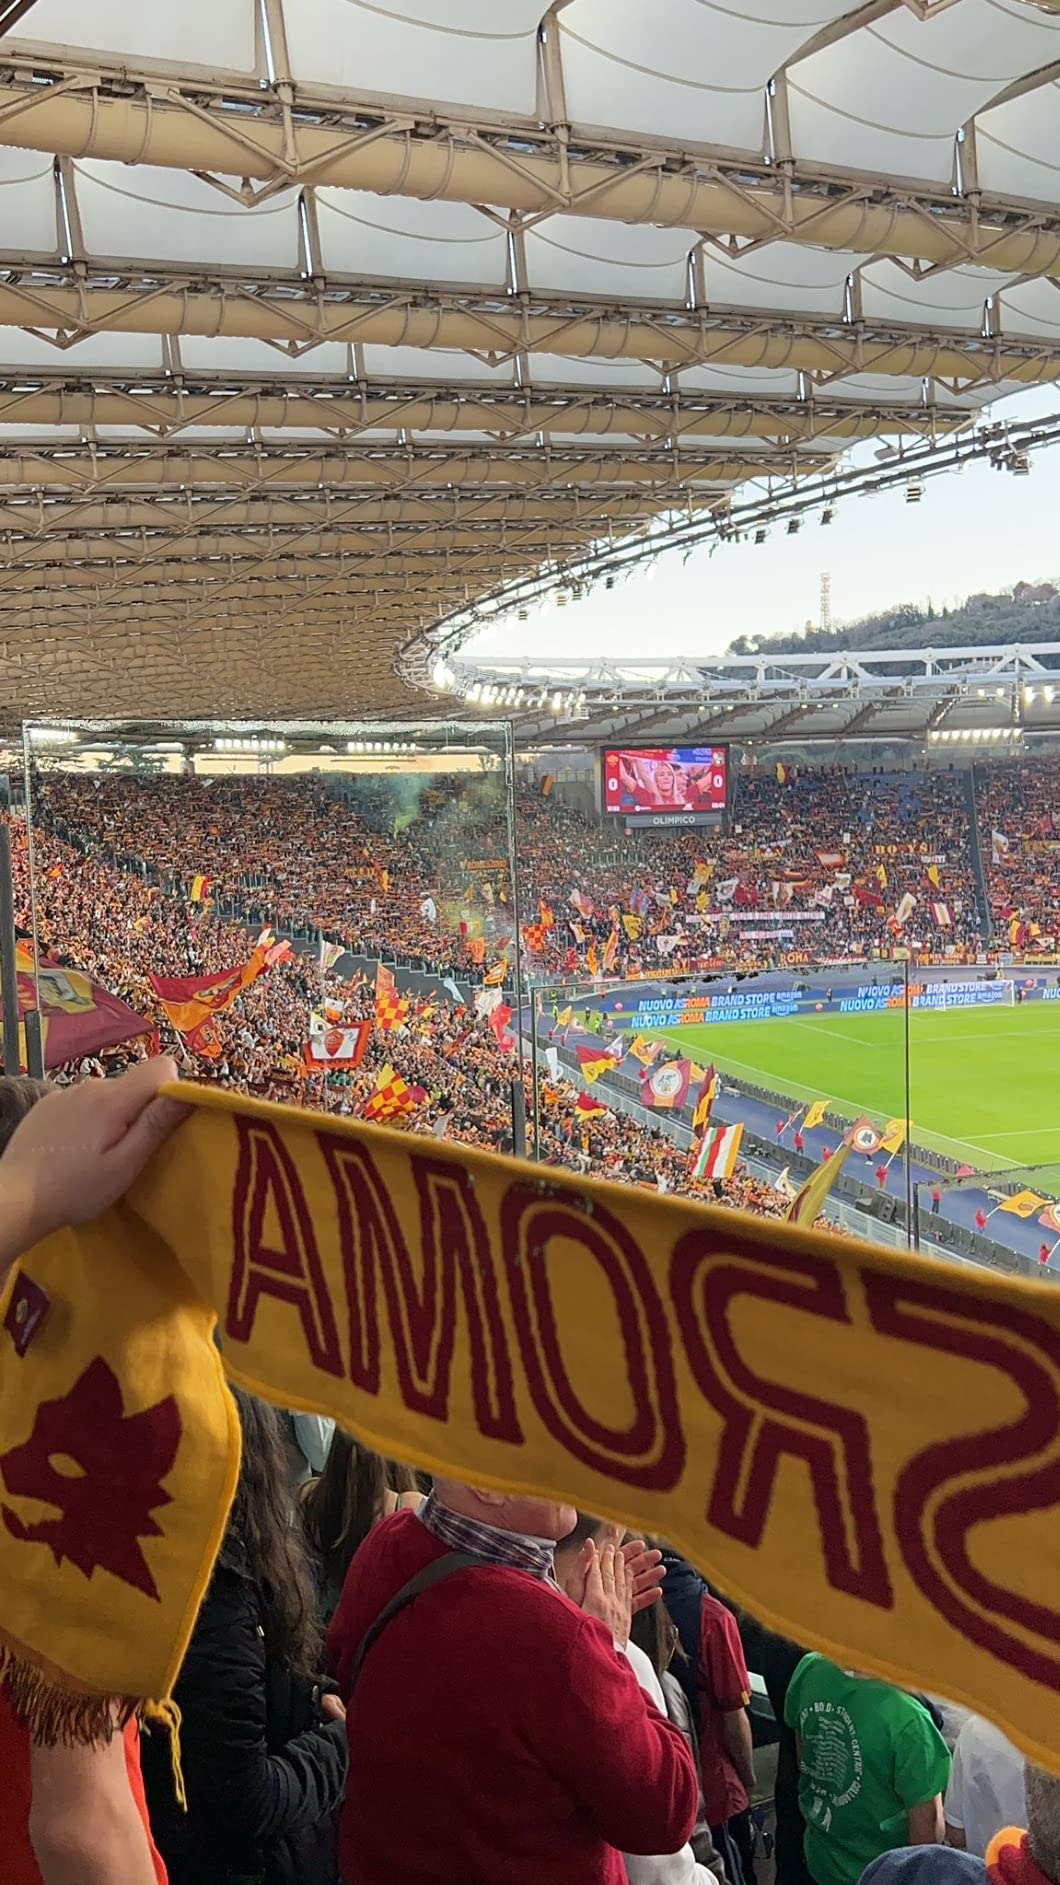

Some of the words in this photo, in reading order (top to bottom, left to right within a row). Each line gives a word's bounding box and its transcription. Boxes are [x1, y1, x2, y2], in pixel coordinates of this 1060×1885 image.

[608, 778, 618, 791] 0
[713, 775, 723, 788] 0
[652, 816, 696, 825] OLIMPICO
[639, 999, 674, 1012] NUOVO
[711, 994, 745, 1007] BRAND
[745, 992, 776, 1005] STORE
[776, 991, 802, 1002] amazon
[840, 999, 875, 1012] NUOVO
[912, 995, 945, 1007] BRAND
[946, 993, 976, 1005] STORE
[631, 1014, 667, 1029] NUOVO
[705, 1009, 739, 1022] BRAND
[739, 1006, 770, 1020] STORE
[771, 1004, 798, 1016] amazon
